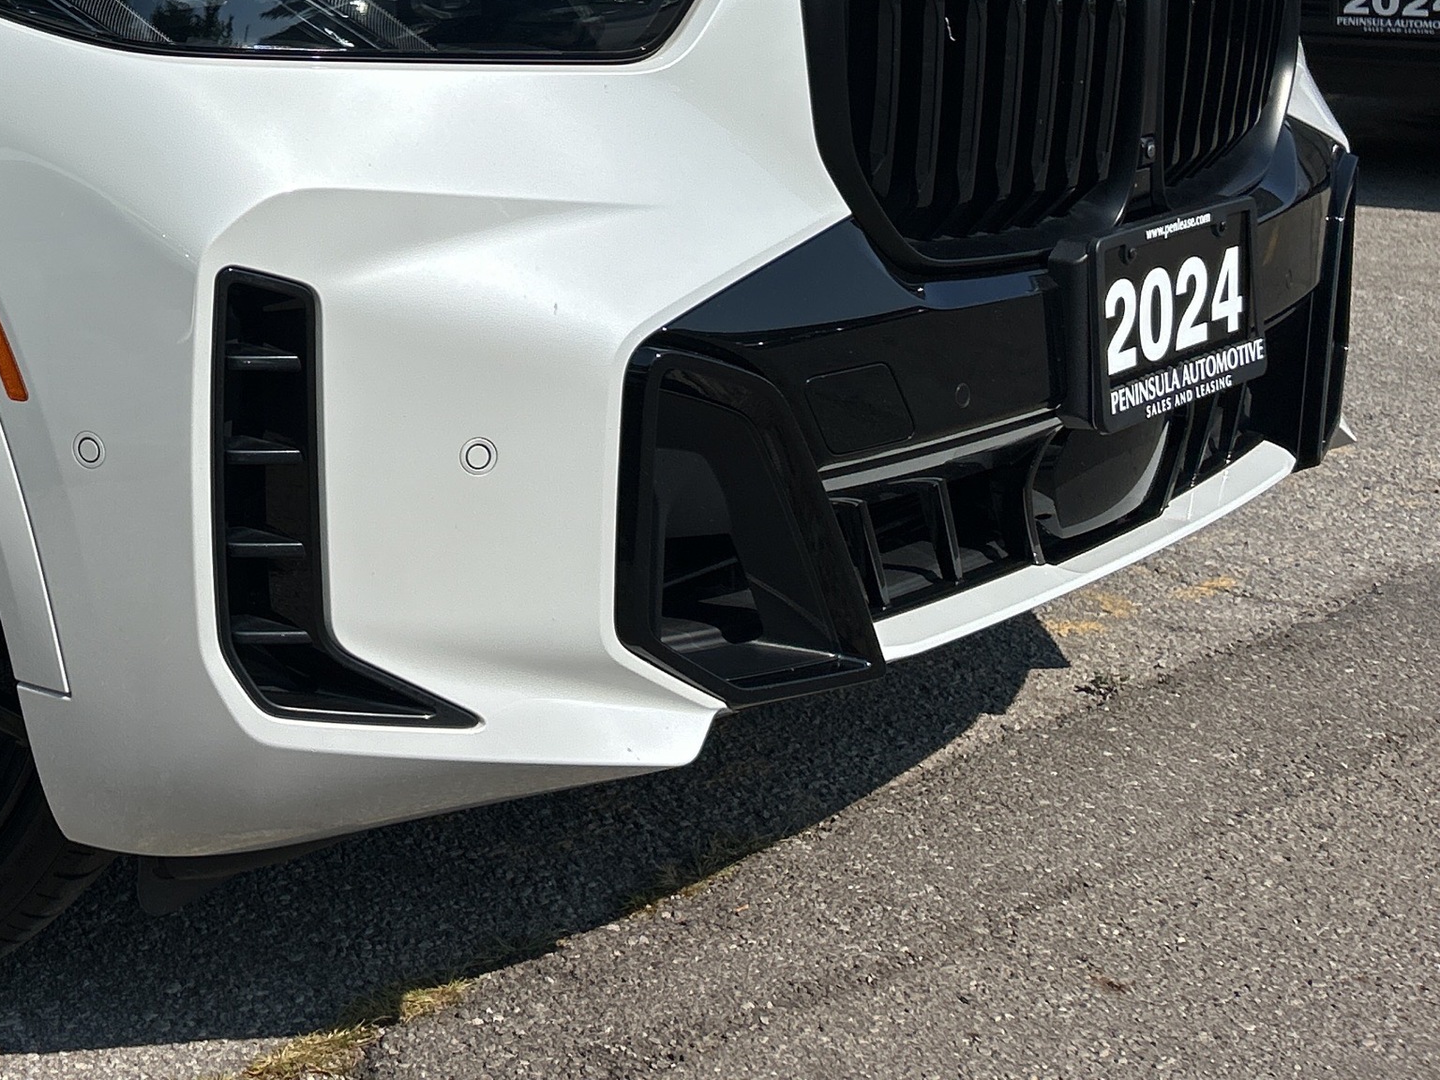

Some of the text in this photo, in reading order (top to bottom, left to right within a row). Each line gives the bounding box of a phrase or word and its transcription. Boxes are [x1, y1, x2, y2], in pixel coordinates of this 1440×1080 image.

[1336, 16, 1440, 31] PENINSULA AUTOMO
[1145, 213, 1211, 240] www.penlease.com
[1105, 245, 1244, 376] 2024
[1111, 338, 1265, 415] PENINSULA AUTOMOTIVE
[1145, 374, 1233, 419] SALES AND LEASING
